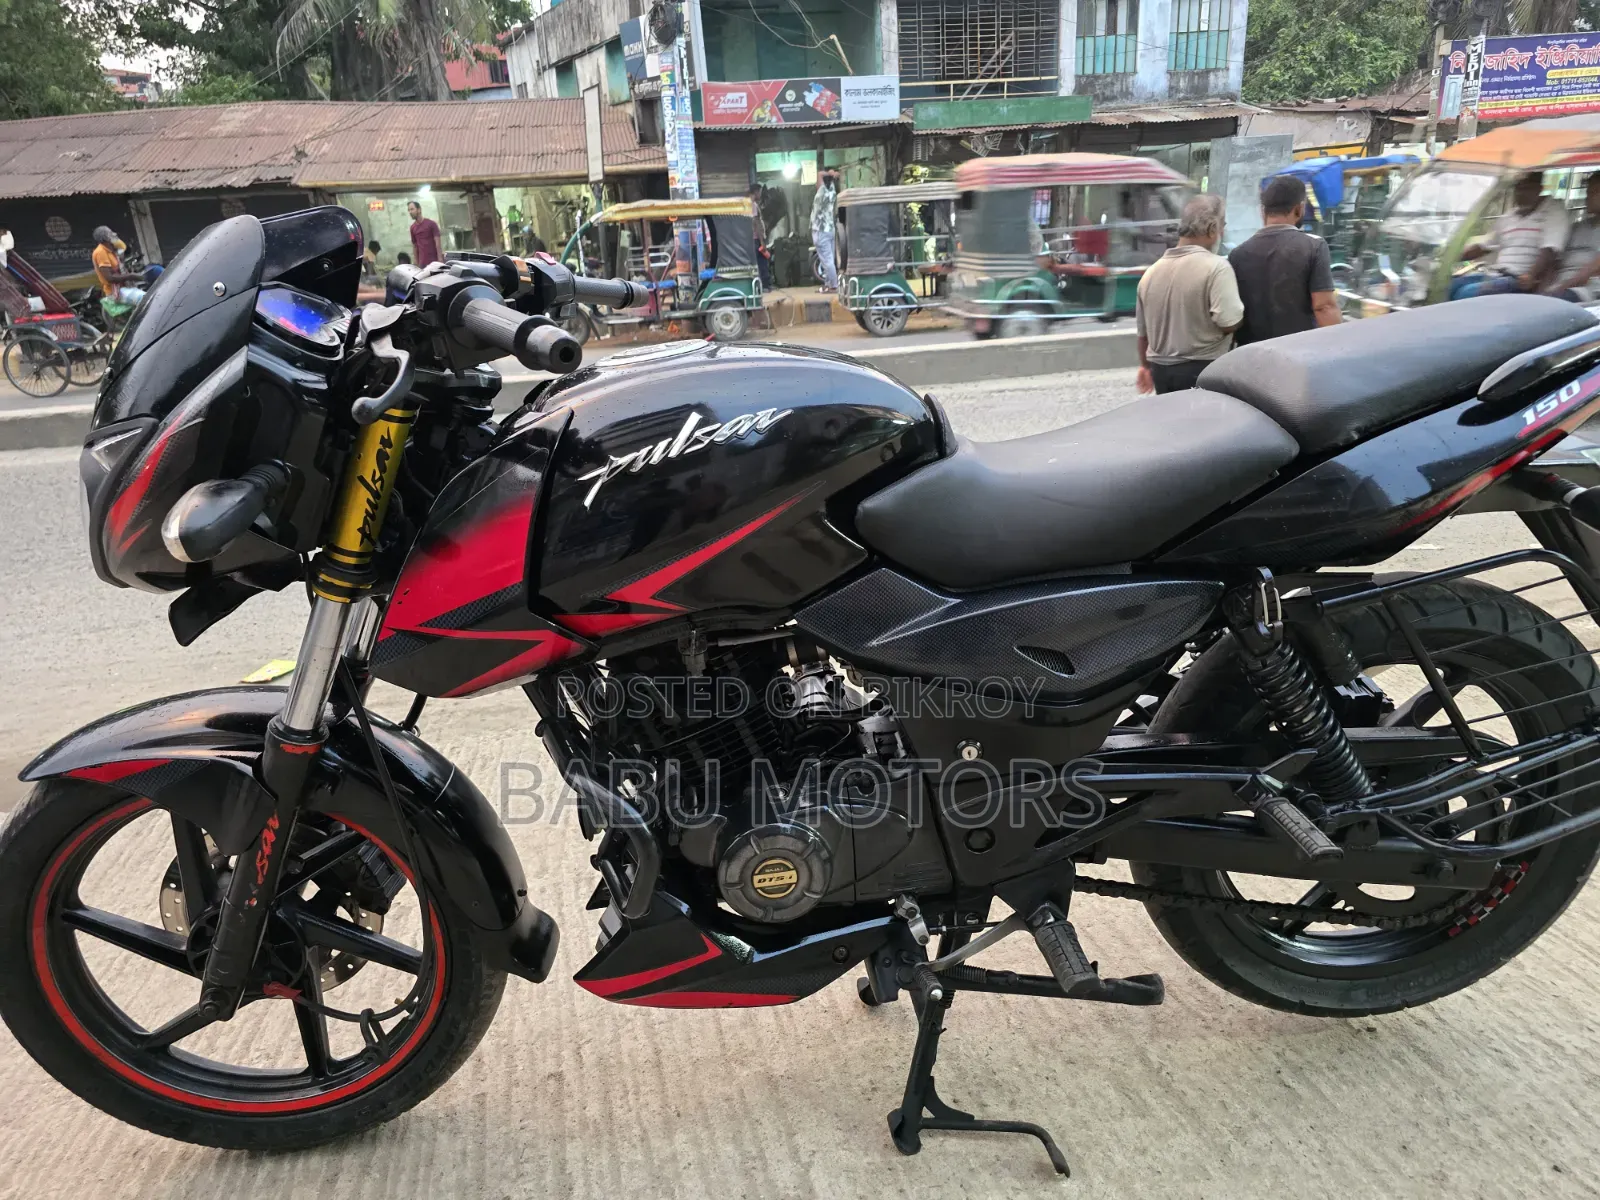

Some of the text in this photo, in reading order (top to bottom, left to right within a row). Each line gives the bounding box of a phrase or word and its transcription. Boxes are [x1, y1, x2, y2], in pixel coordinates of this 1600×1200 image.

[1465, 43, 1482, 80] MEDI
[1484, 48, 1533, 72] জাহিদ
[1522, 380, 1580, 425] 150
